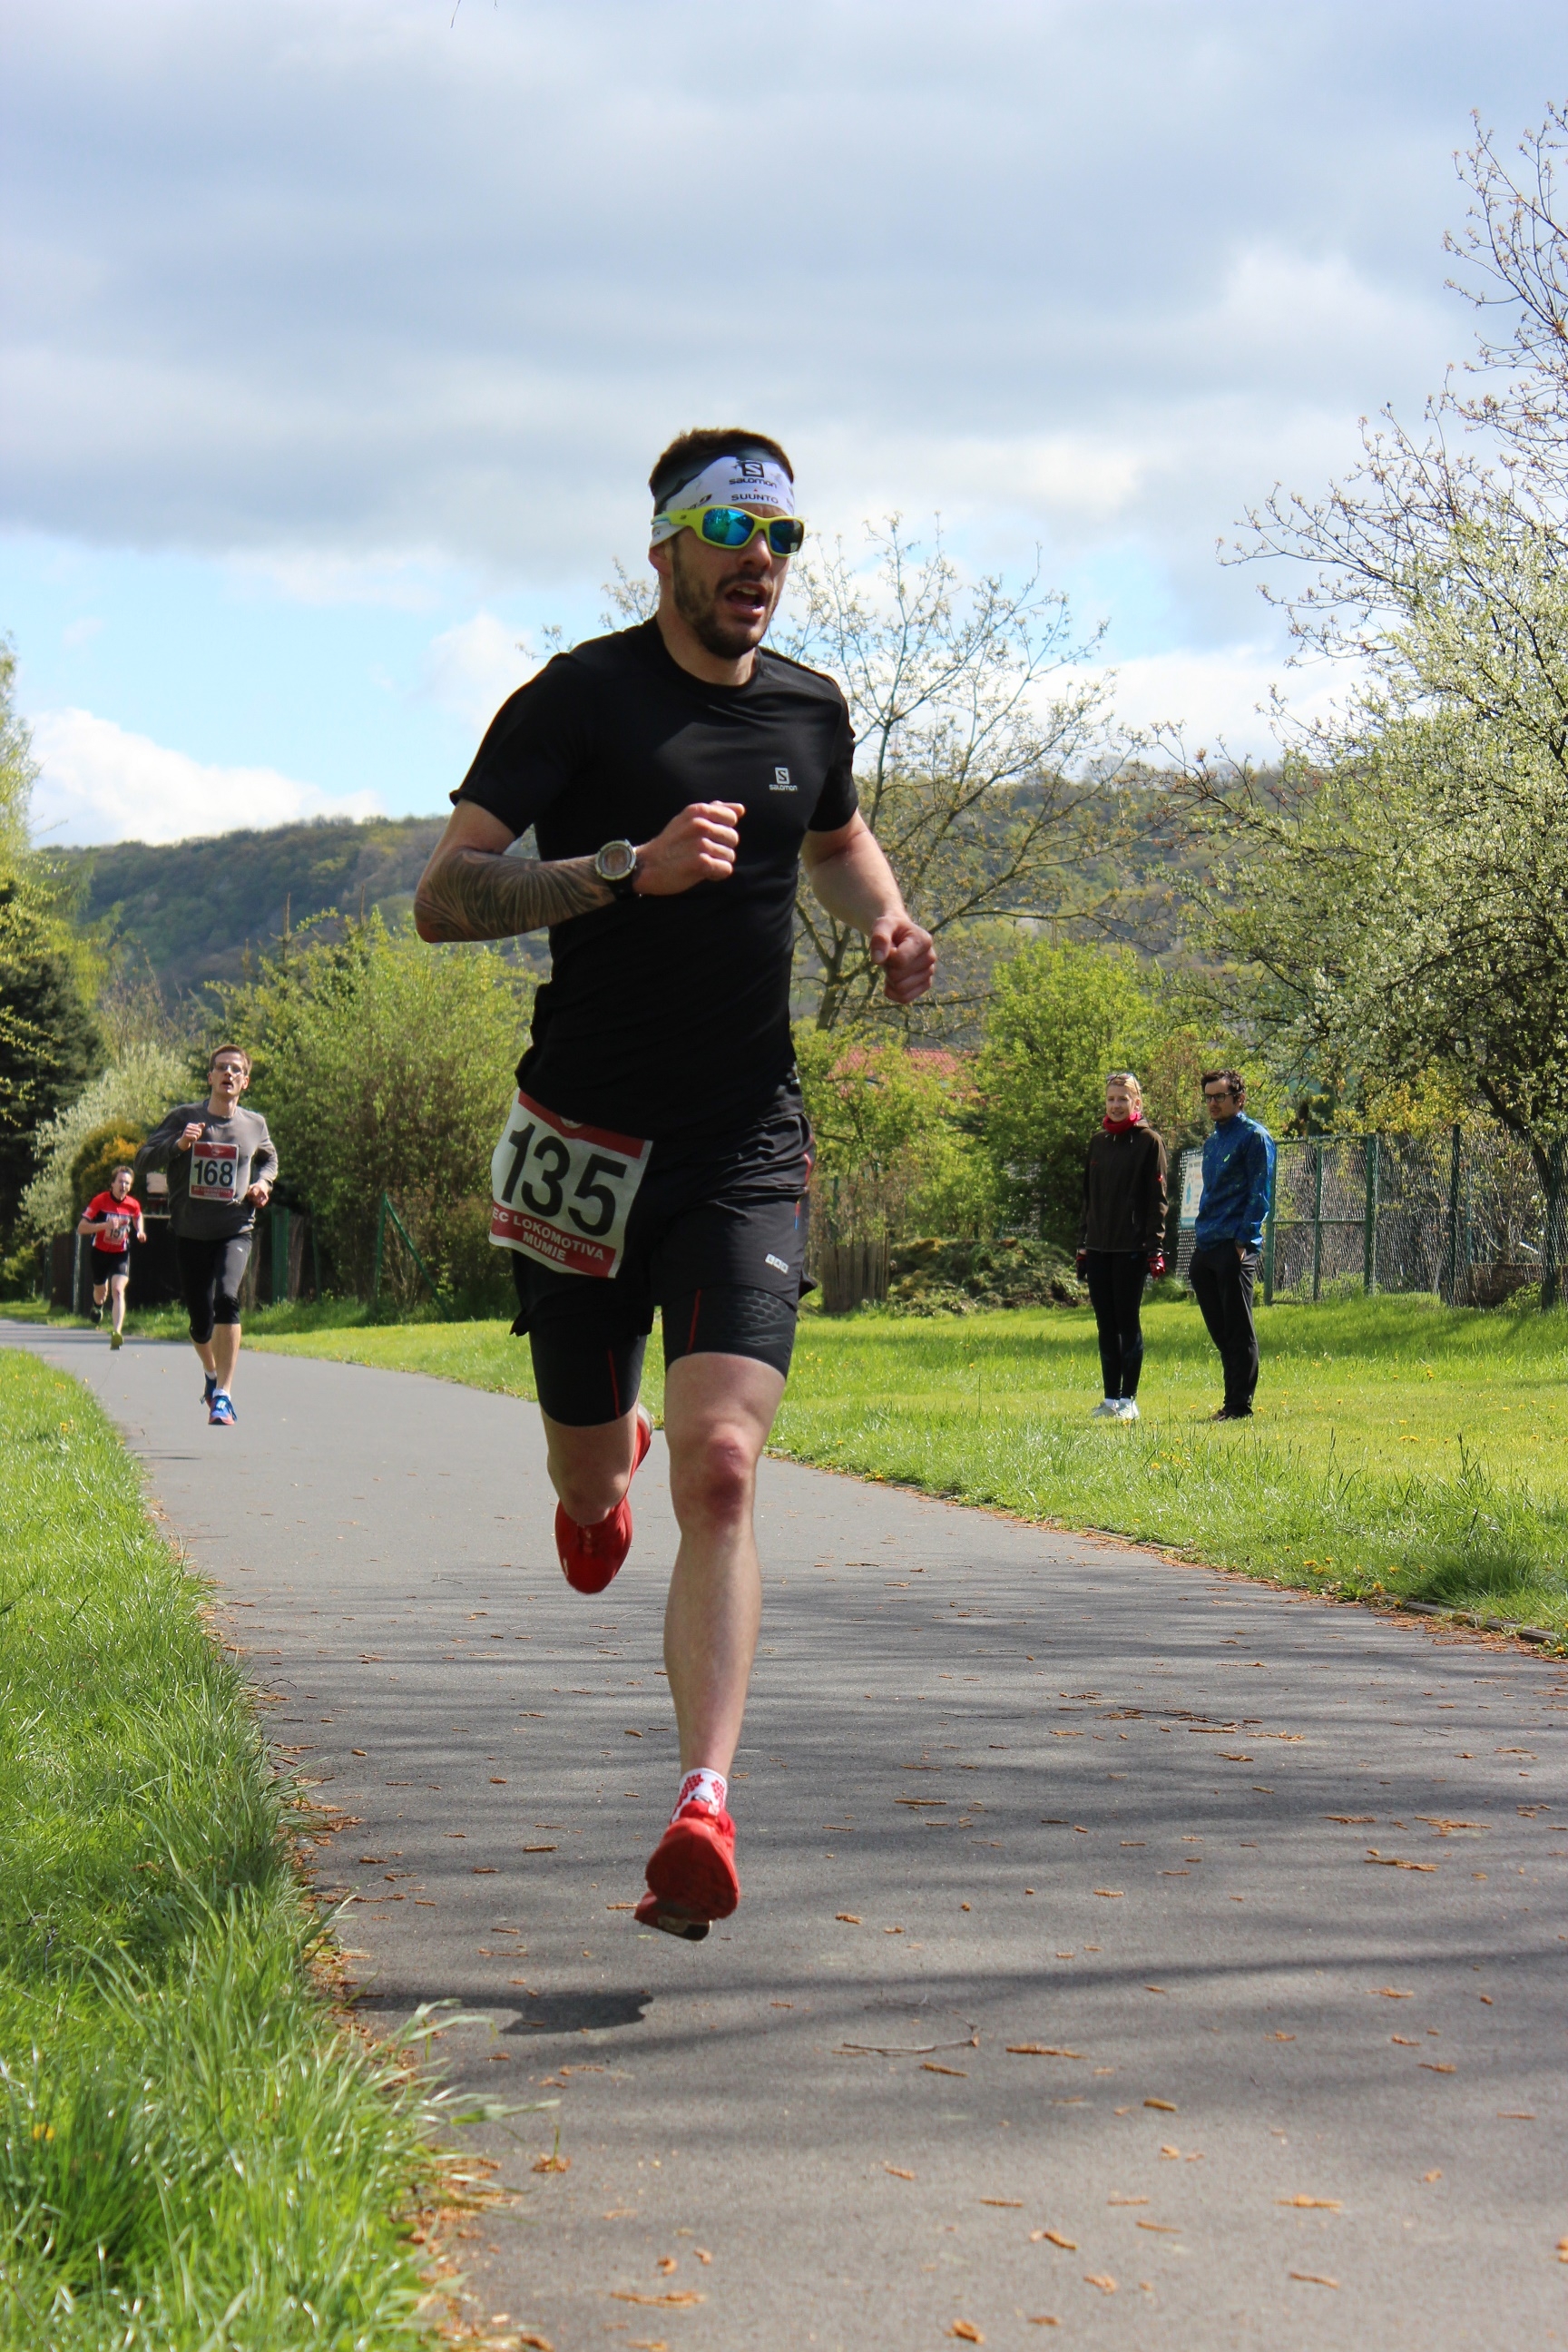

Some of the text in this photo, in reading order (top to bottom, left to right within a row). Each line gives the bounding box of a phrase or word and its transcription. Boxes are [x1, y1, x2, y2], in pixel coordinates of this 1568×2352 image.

[730, 493, 779, 505] SUUNTO
[193, 1160, 233, 1187] 168
[501, 1122, 628, 1237] 135
[513, 1215, 604, 1261] LOKOMOTIVA
[523, 1231, 567, 1261] MUMIE
